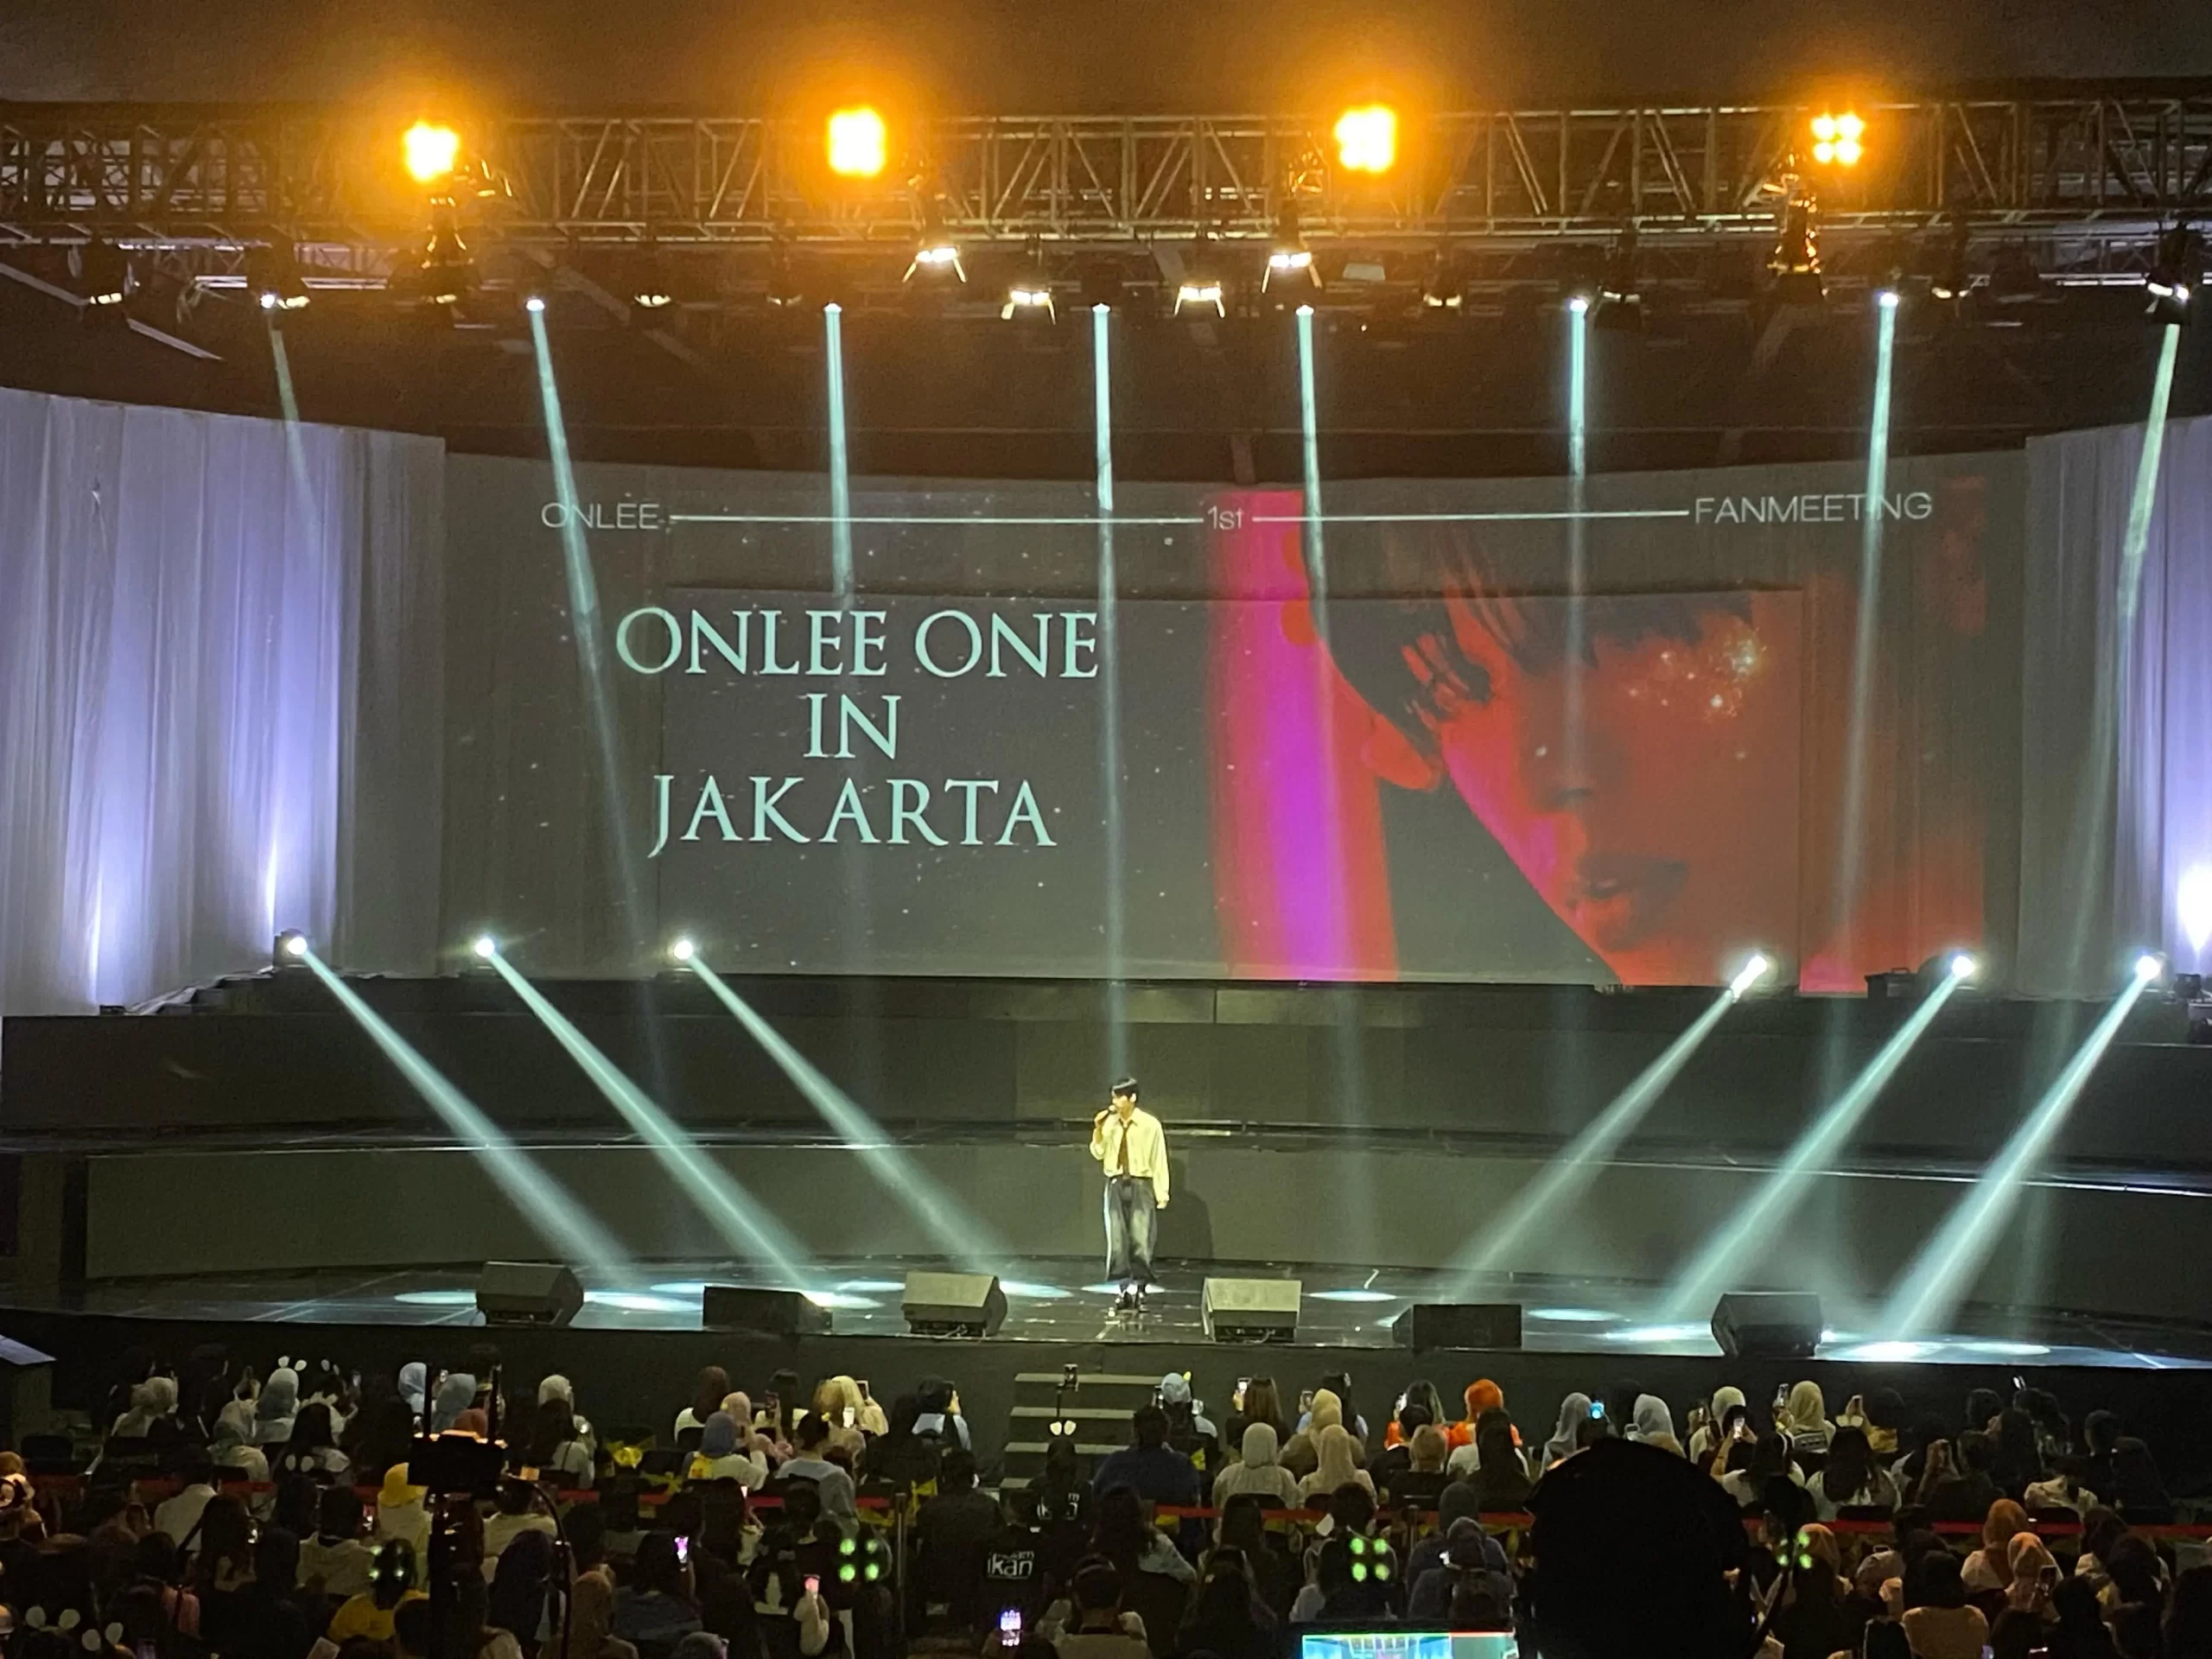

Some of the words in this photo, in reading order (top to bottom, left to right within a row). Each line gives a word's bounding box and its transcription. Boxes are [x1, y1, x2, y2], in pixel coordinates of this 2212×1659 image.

[541, 501, 660, 530] ONLEE
[1207, 505, 1244, 531] 1st
[615, 607, 887, 677] ONLEE
[914, 609, 1098, 678] ONE
[803, 692, 902, 760] IN
[647, 774, 1058, 860] JAKARTA
